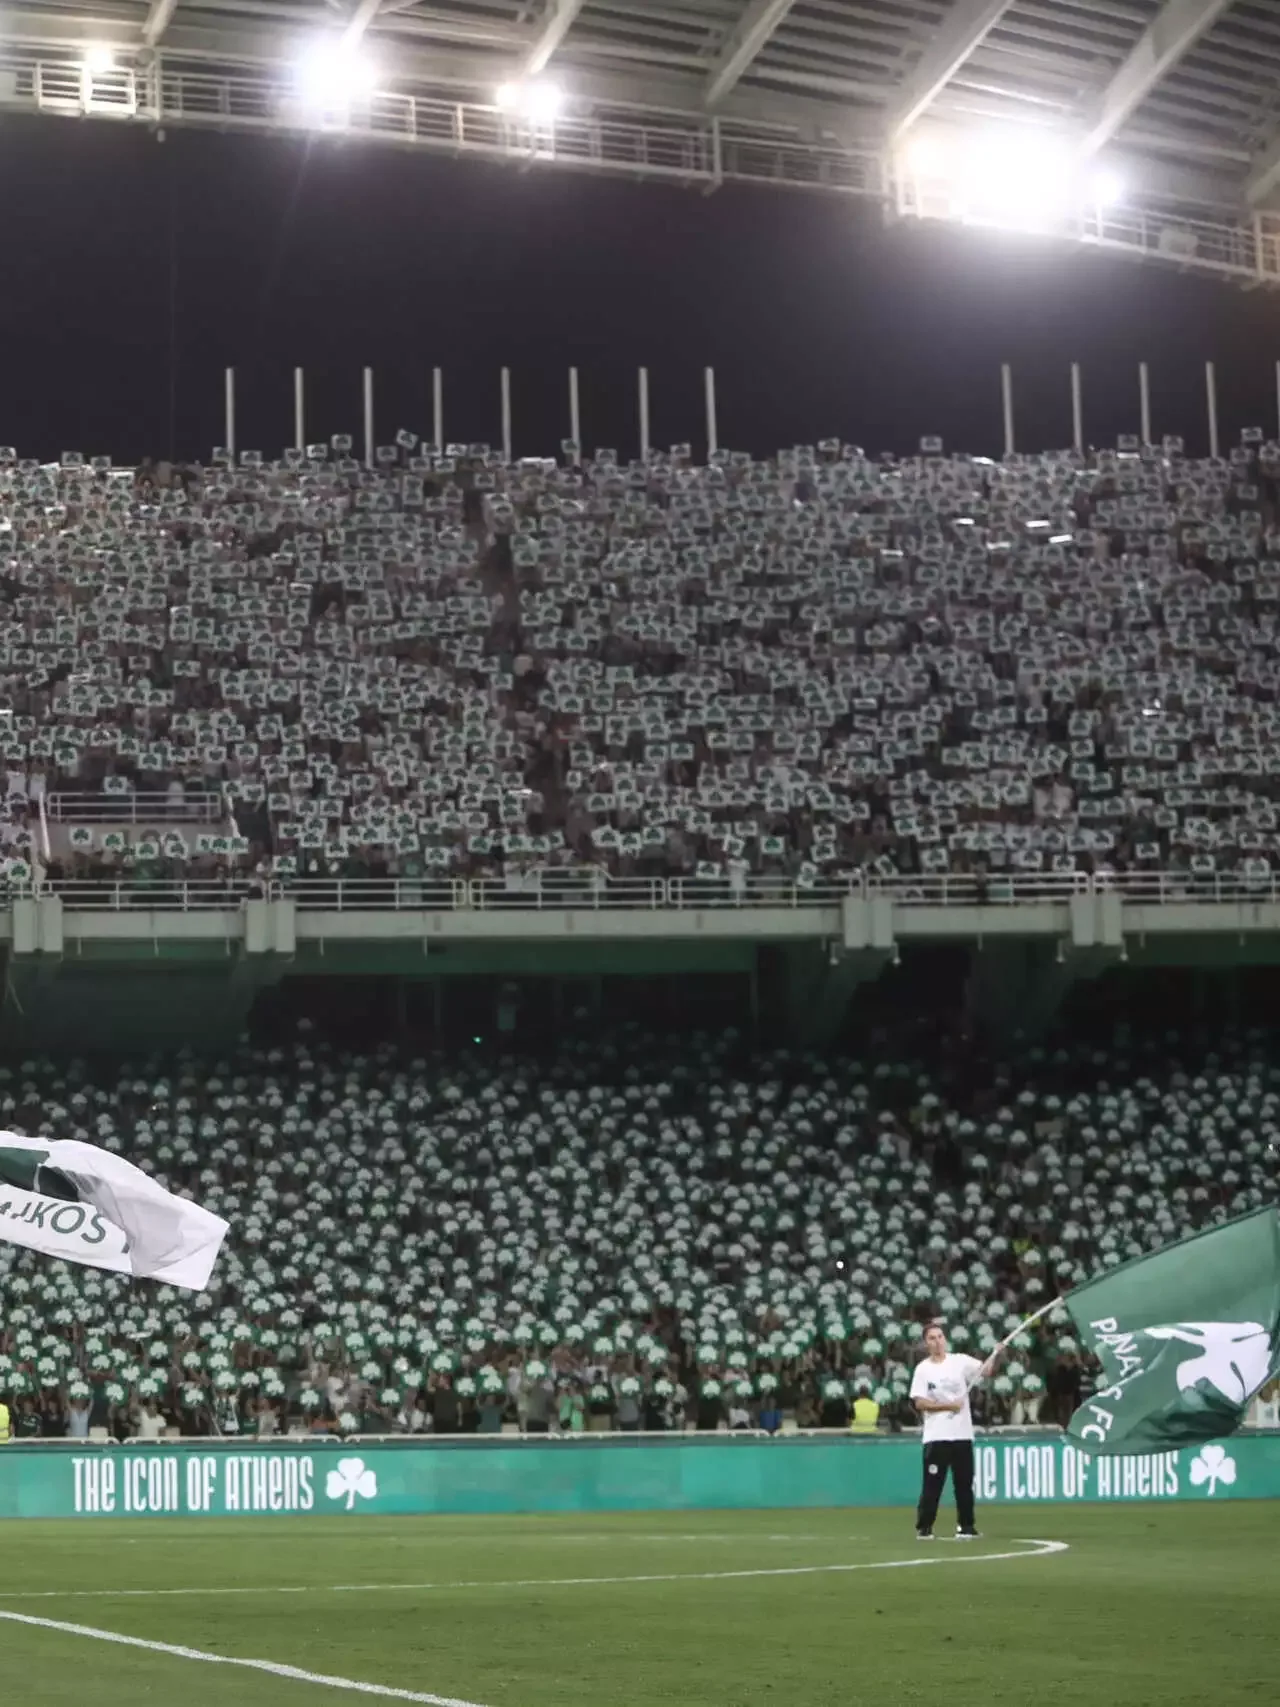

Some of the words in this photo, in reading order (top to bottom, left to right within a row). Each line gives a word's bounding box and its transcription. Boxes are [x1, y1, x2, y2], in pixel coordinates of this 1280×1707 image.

[1080, 1404, 1114, 1443] FC
[71, 1457, 115, 1512] THE
[124, 1457, 177, 1511] ICON
[186, 1456, 217, 1511] OF
[225, 1456, 314, 1510] ATHENS
[1004, 1446, 1055, 1498] ICON
[1062, 1445, 1091, 1497] OF
